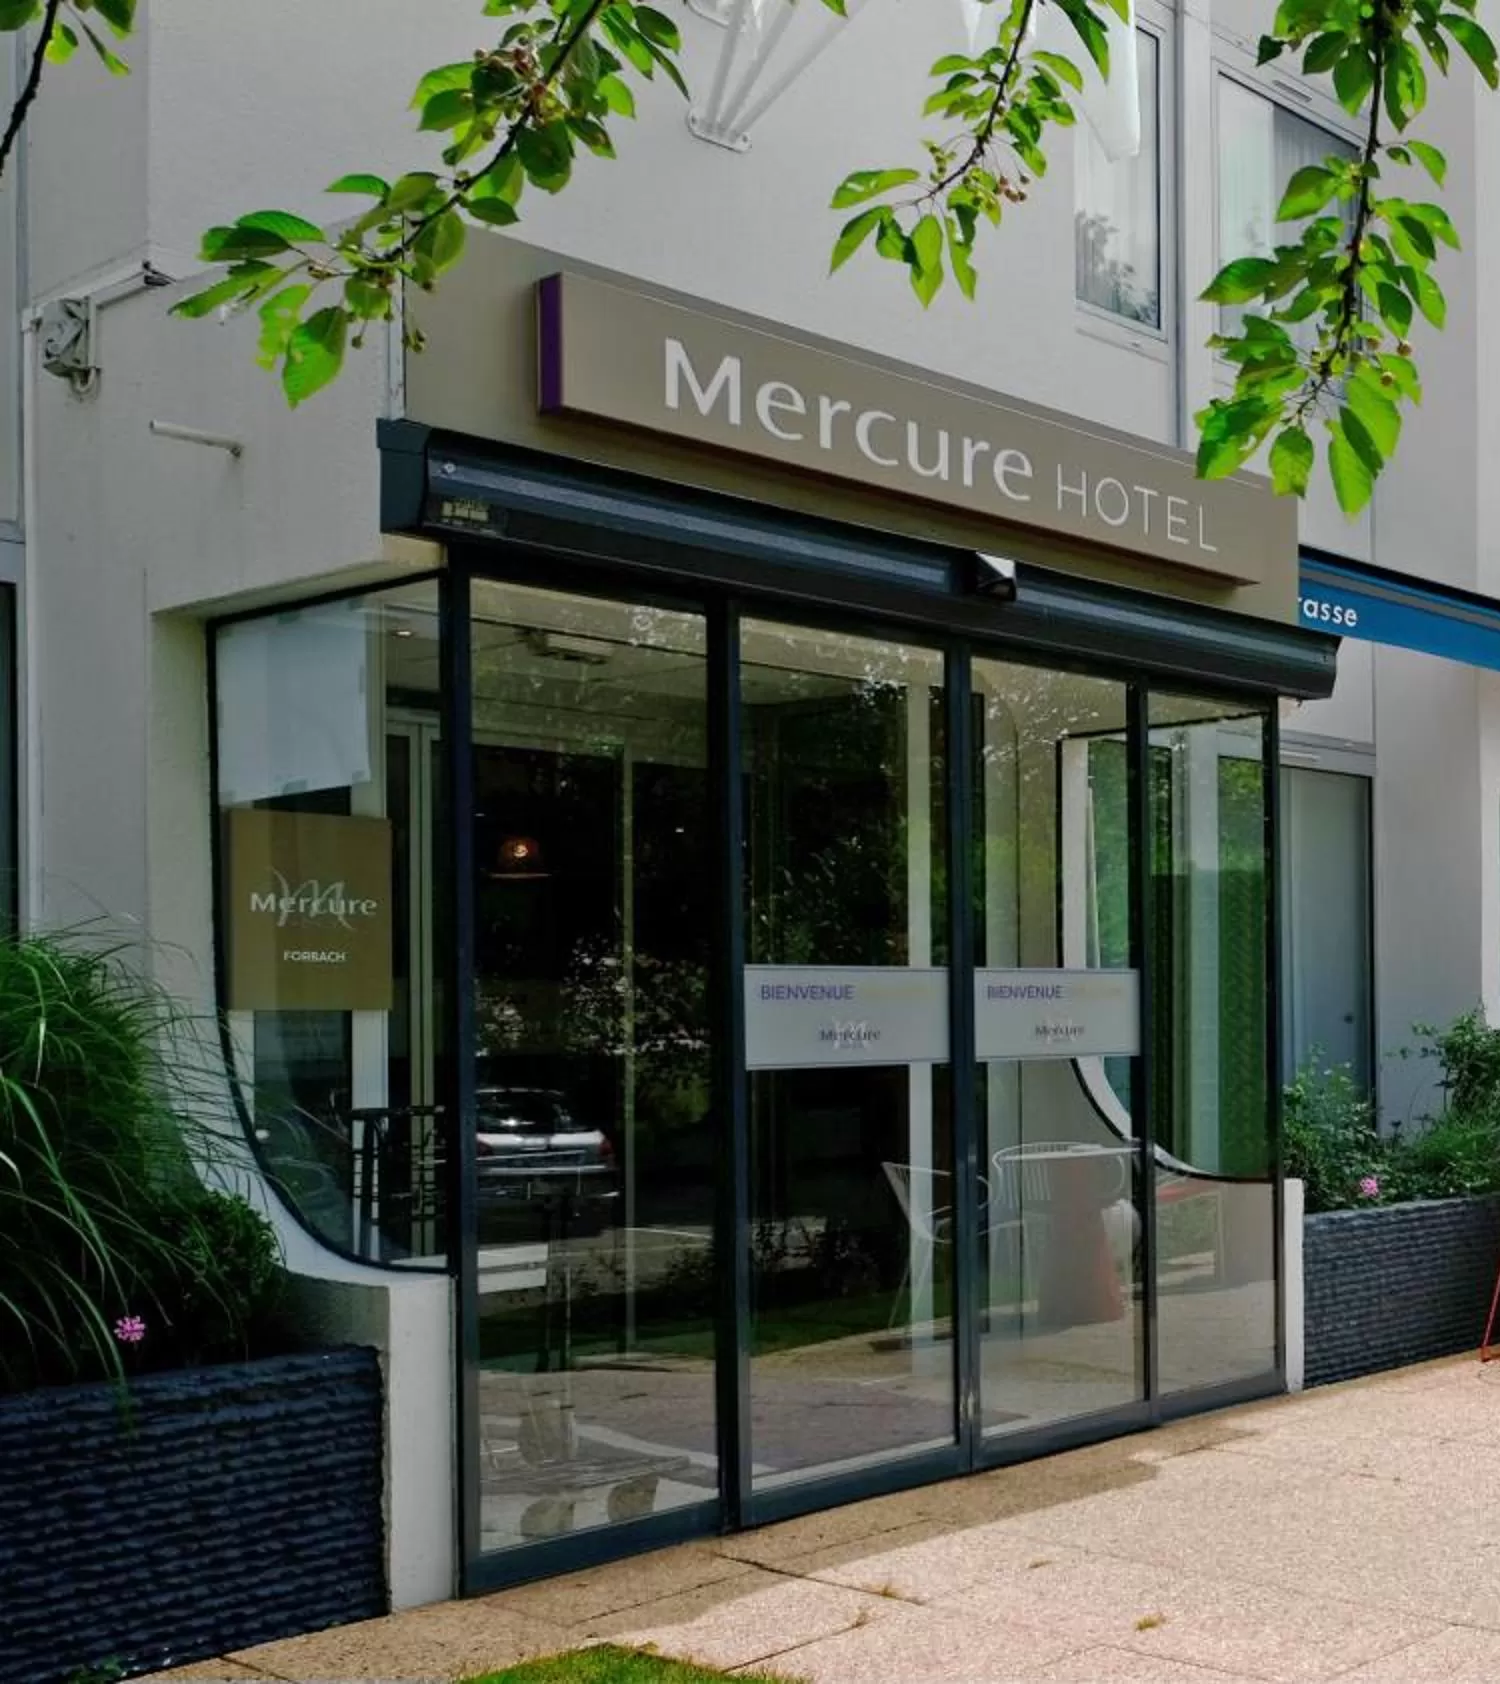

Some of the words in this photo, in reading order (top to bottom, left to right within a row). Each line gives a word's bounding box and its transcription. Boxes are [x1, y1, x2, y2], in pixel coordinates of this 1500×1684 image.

[664, 337, 1034, 502] Mercure
[1056, 463, 1218, 552] HOTEL
[1298, 597, 1359, 627] asse
[250, 891, 377, 916] Mercure
[760, 984, 855, 1001] BIENVENUE
[987, 984, 1062, 1000] BIENVENUE
